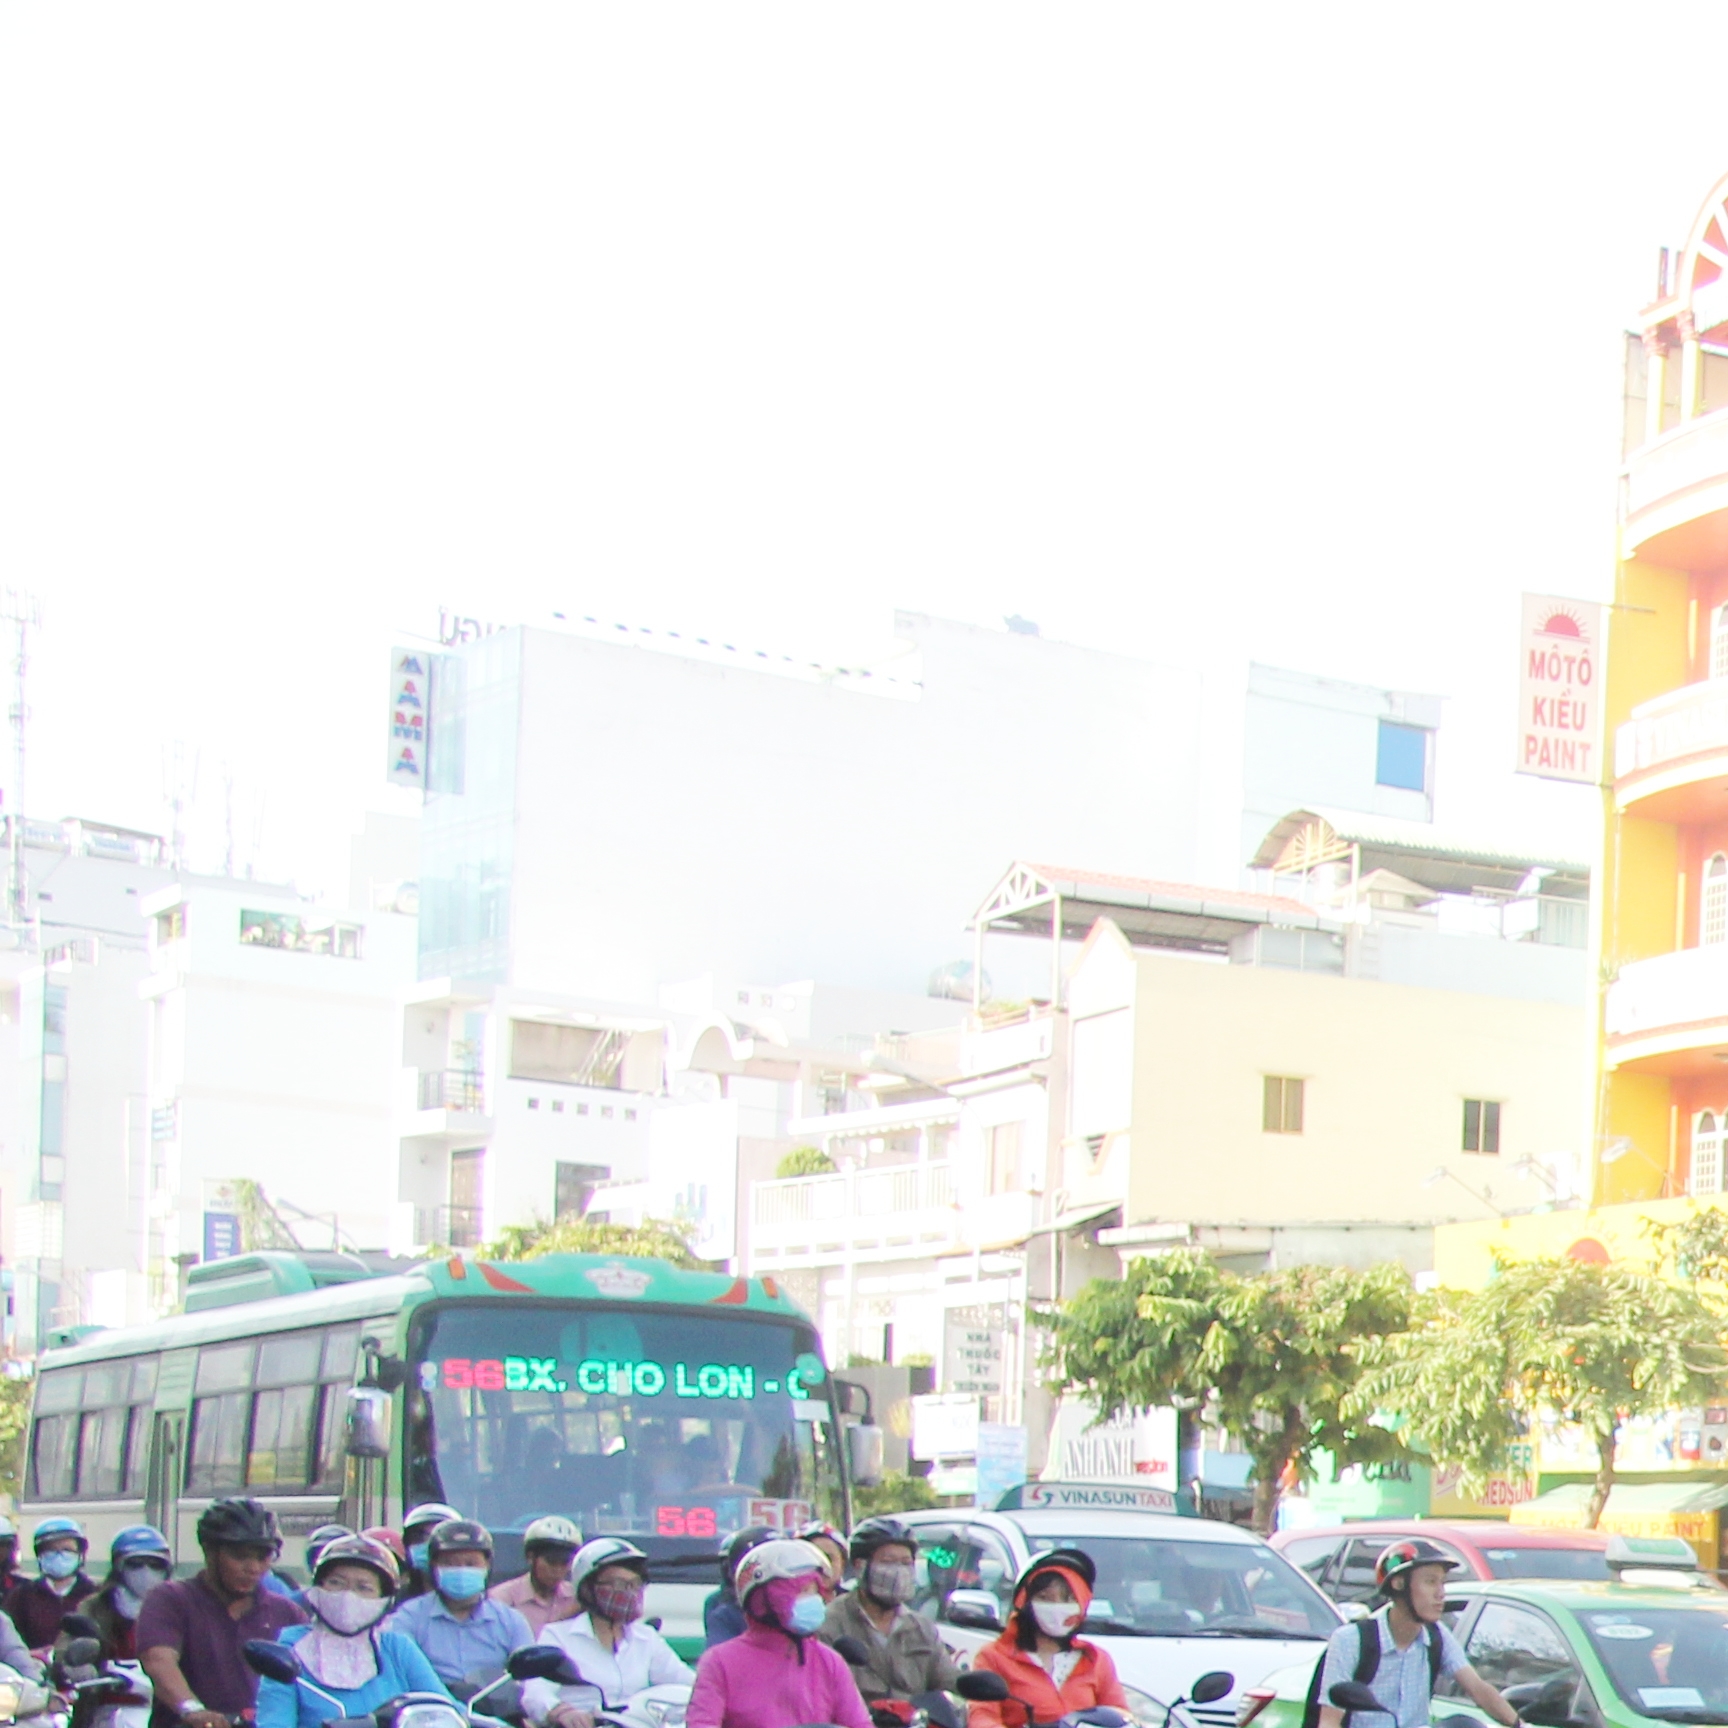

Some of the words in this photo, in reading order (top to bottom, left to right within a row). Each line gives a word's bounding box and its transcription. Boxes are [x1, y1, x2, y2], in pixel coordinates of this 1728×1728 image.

[1528, 643, 1593, 687] MÔTÔ
[1524, 733, 1592, 774] PAINT
[443, 1358, 504, 1391] 56
[675, 1362, 755, 1400] LON
[656, 1505, 717, 1538] 56
[751, 1500, 811, 1530] 56
